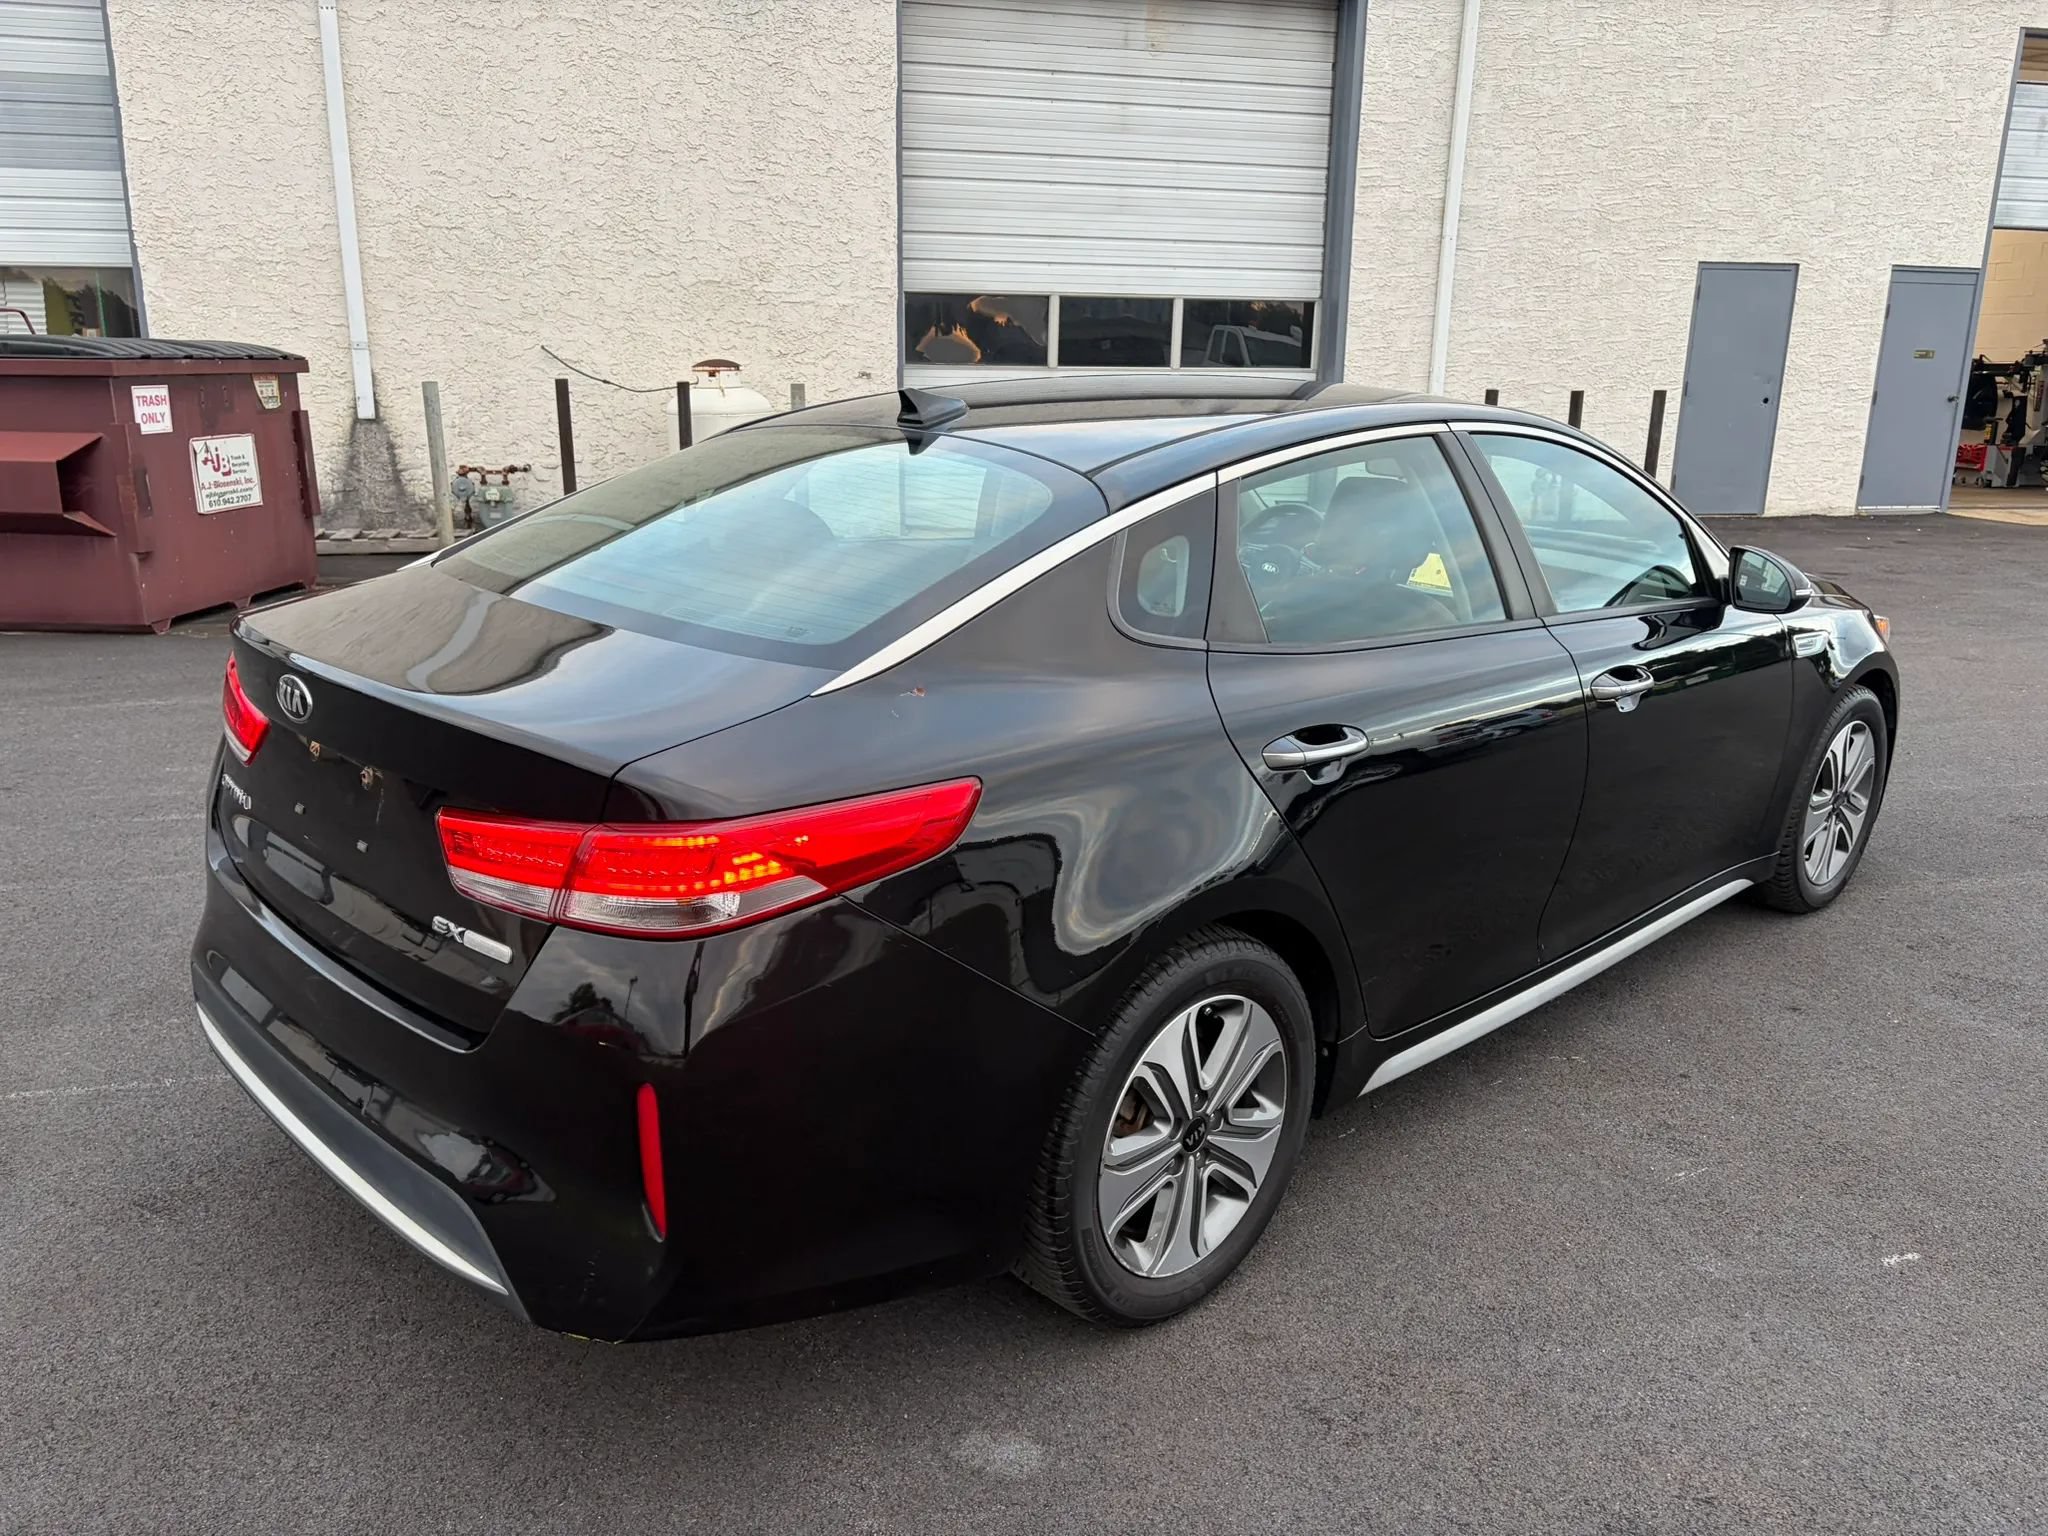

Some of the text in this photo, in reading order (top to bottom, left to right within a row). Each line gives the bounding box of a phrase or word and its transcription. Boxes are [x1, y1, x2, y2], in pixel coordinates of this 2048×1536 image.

[135, 394, 167, 407] TRASH
[141, 411, 166, 425] ONLY
[208, 493, 252, 508] 610.942.2707
[278, 680, 304, 715] KIA
[431, 915, 467, 943] EX
[1185, 1122, 1206, 1146] KIA
